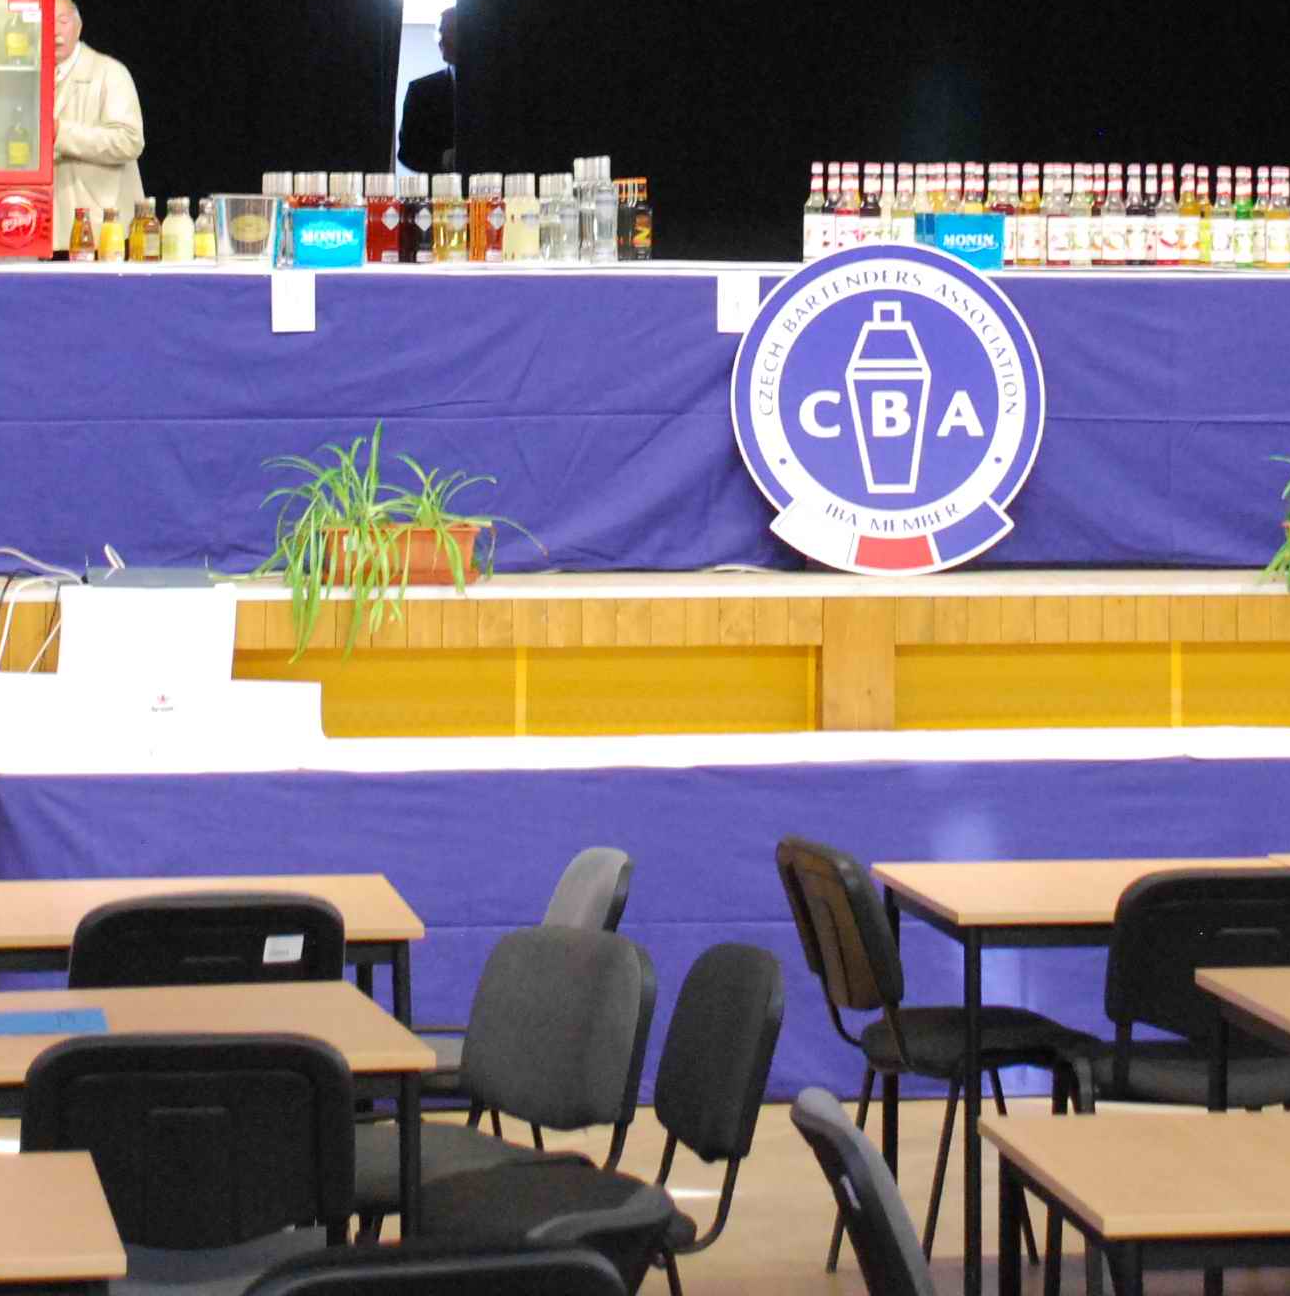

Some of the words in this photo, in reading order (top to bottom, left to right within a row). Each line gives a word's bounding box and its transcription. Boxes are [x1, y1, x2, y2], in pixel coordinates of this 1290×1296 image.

[942, 233, 994, 249] MONIN
[758, 342, 784, 417] CZECH
[782, 269, 923, 334] BARTENDERS
[934, 283, 1018, 416] ASSOCIATION
[824, 502, 859, 528] IBA
[869, 501, 961, 533] MEMBER
